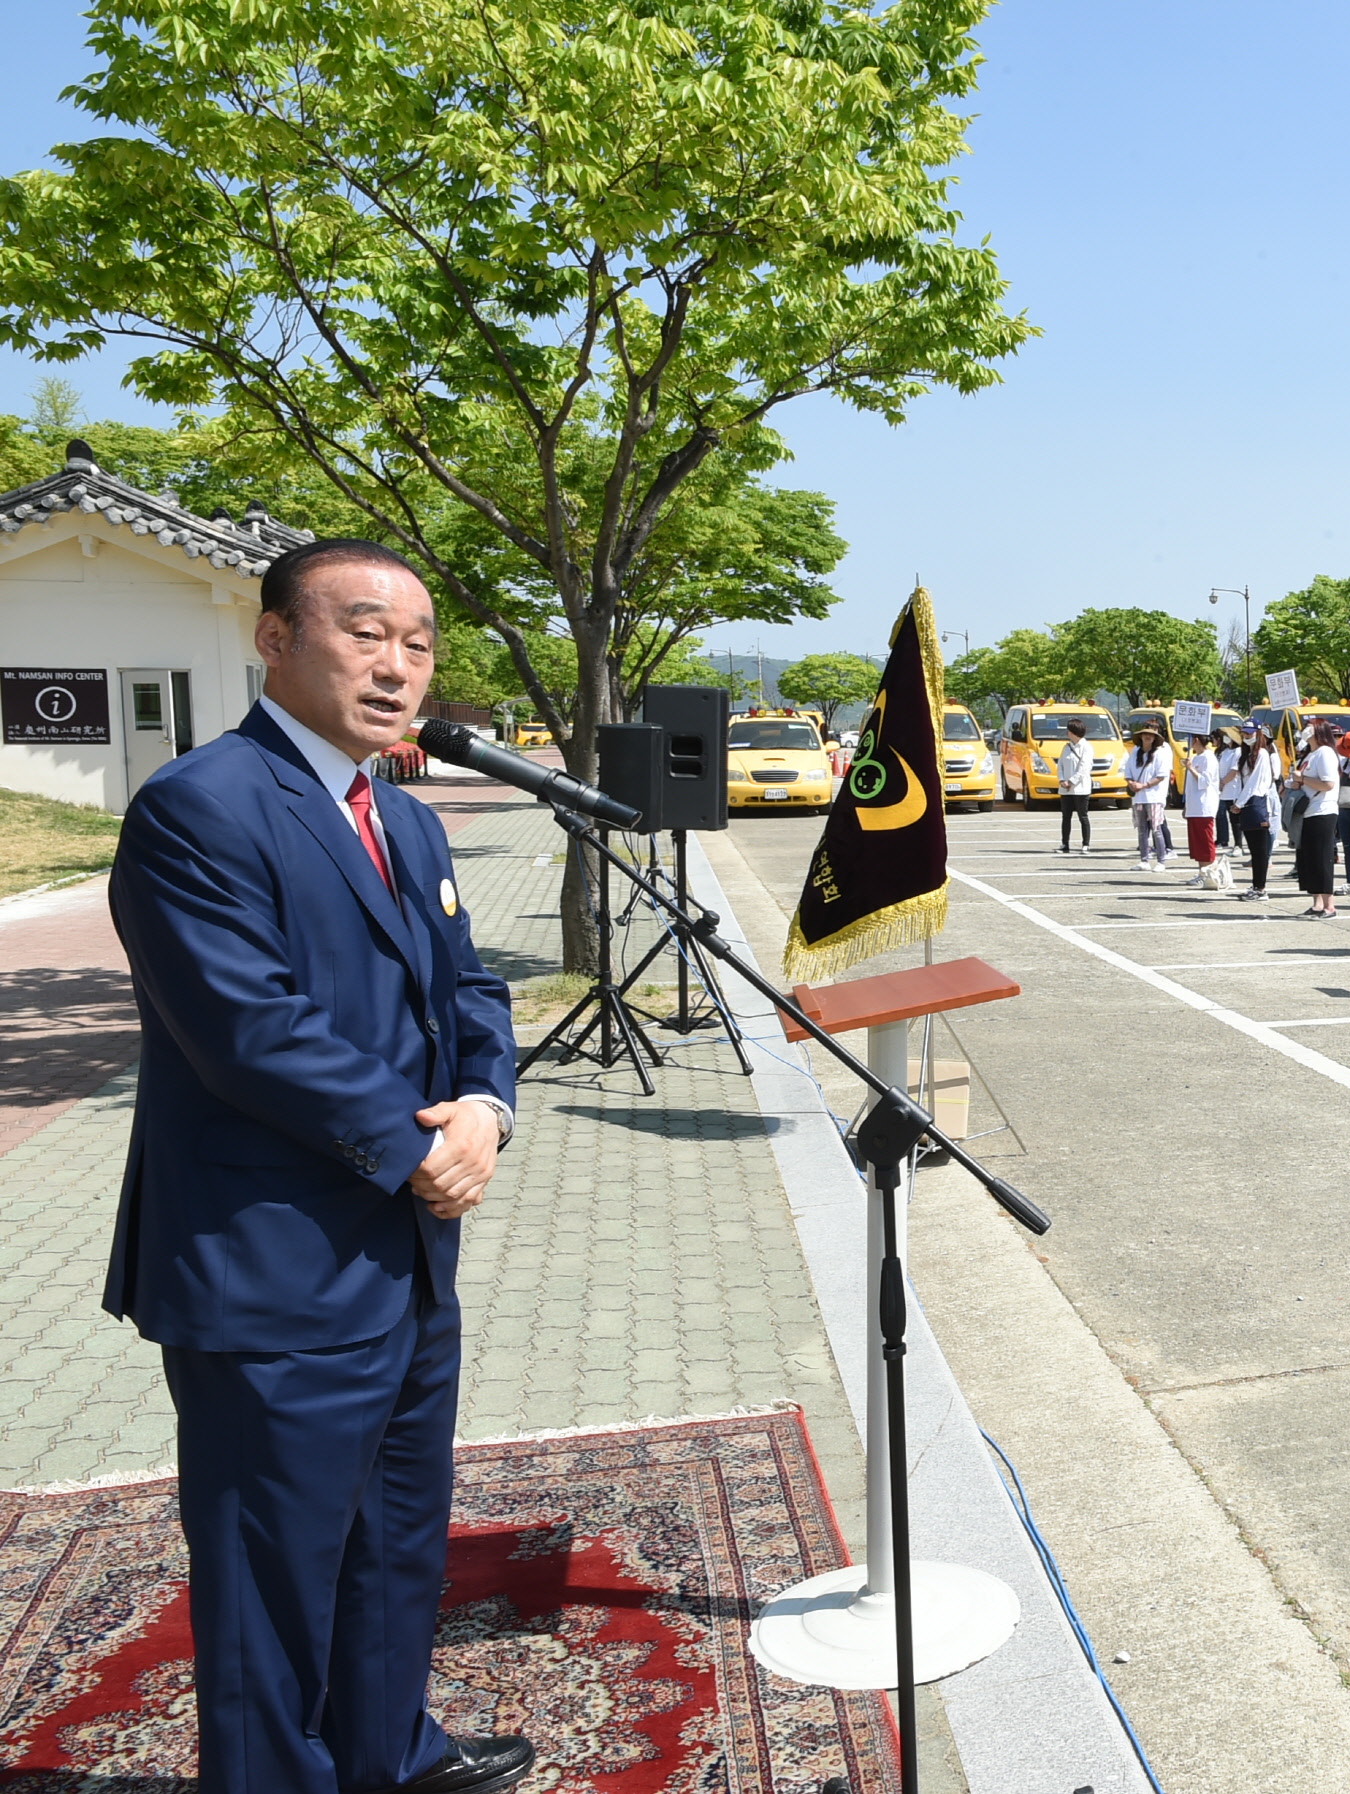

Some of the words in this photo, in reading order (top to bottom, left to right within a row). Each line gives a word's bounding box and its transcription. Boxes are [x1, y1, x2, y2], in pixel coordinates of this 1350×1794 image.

[19, 672, 53, 680] NAMSAN
[55, 672, 73, 680] INFO
[75, 673, 104, 681] CENTER
